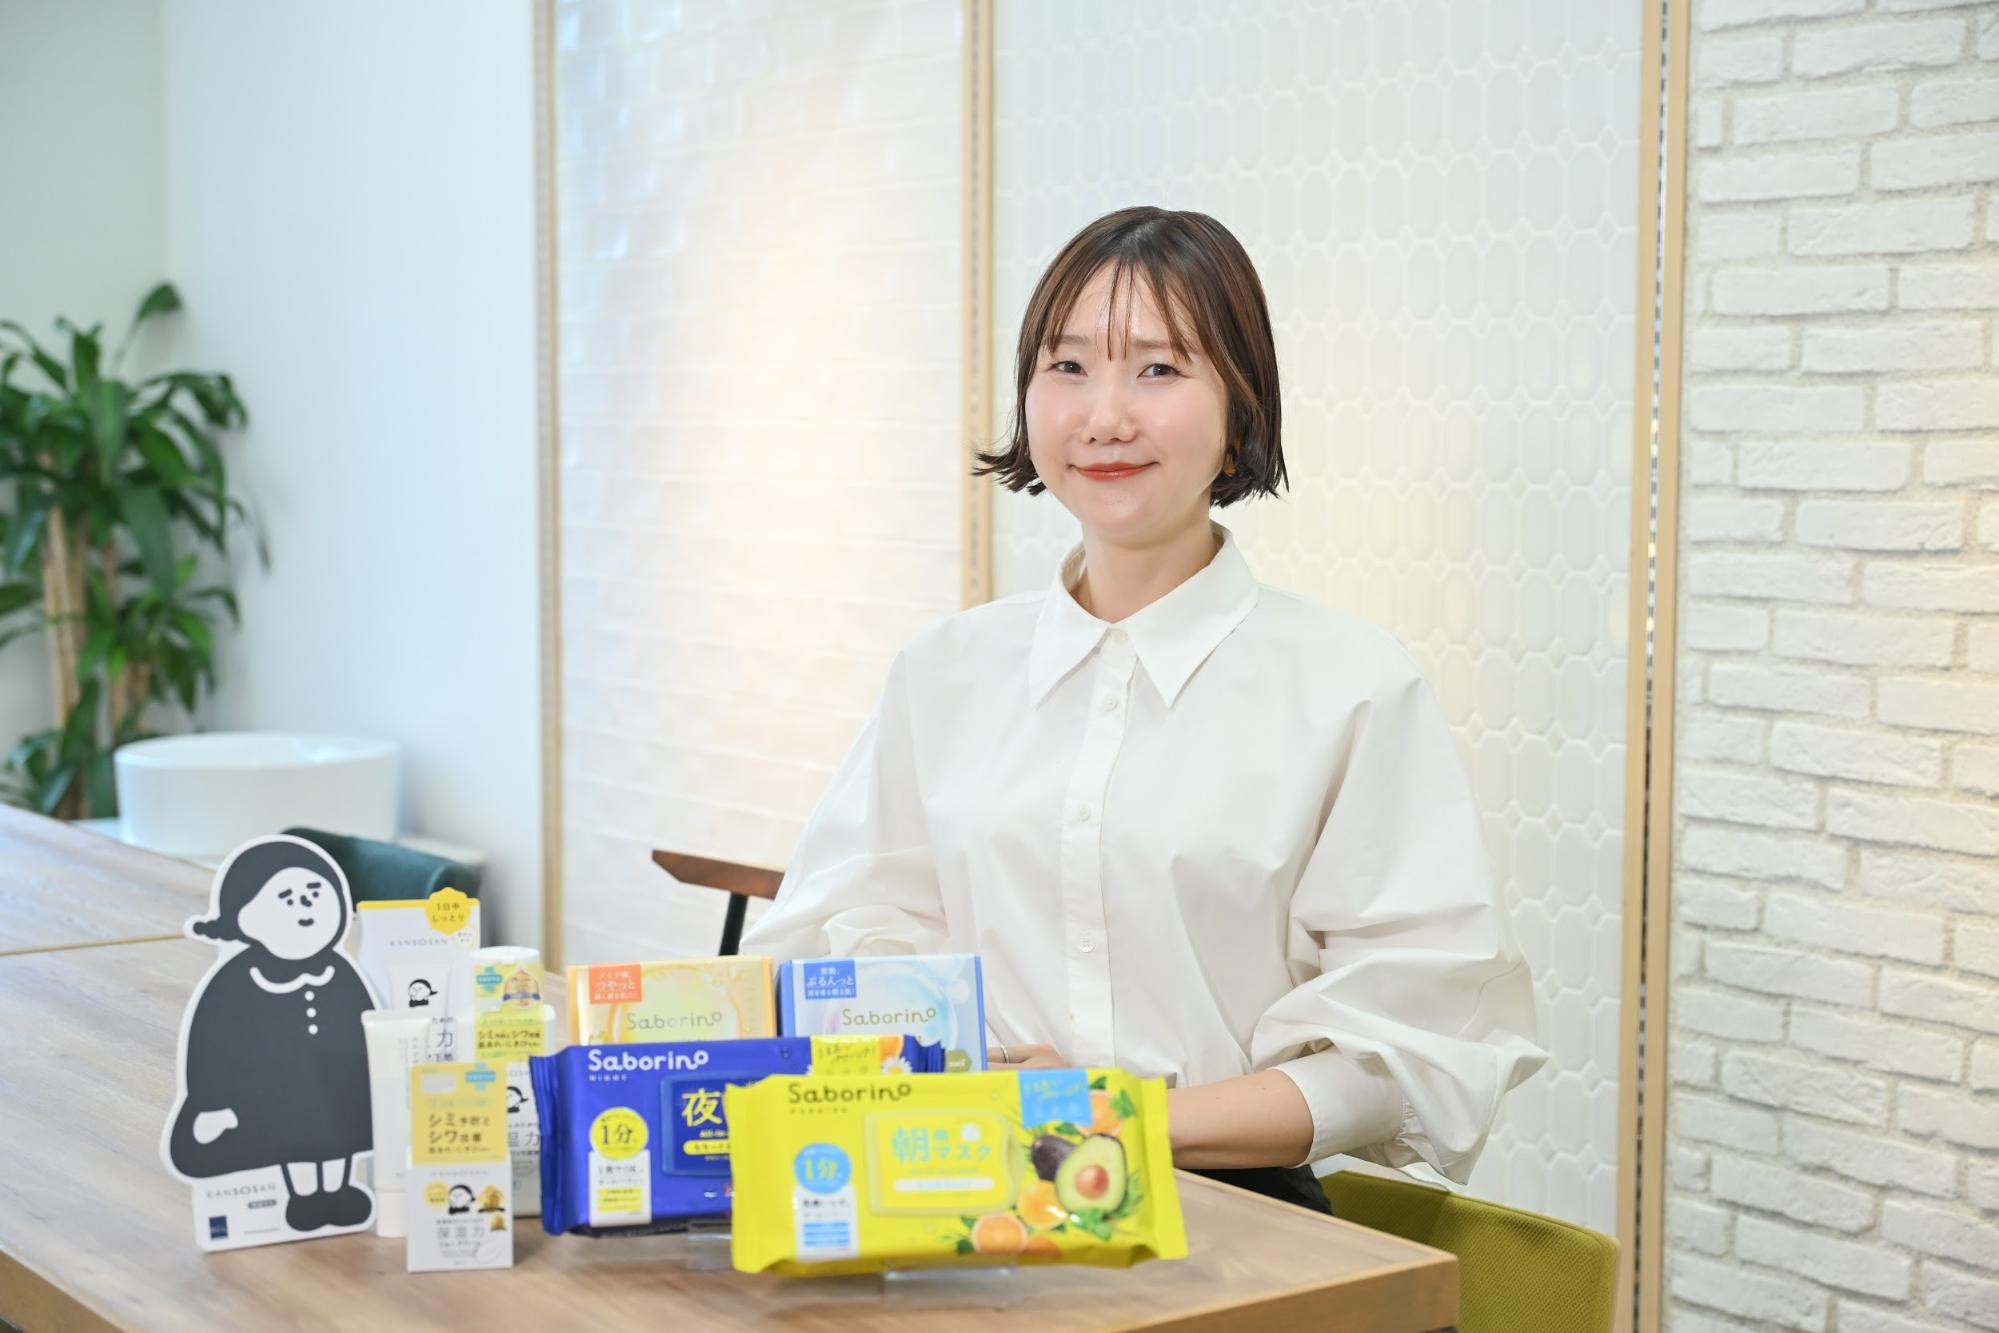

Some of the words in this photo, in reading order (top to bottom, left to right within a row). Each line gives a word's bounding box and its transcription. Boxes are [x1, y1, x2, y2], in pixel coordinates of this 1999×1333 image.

[436, 902, 460, 911] 1日中
[594, 979, 636, 991] つやっと
[626, 1011, 722, 1031] Saborino
[842, 1007, 937, 1026] Saborino
[436, 1028, 454, 1048] 力
[588, 1048, 710, 1072] Saborino
[788, 1082, 912, 1104] Saborino
[206, 1184, 276, 1199] KANSOSAN
